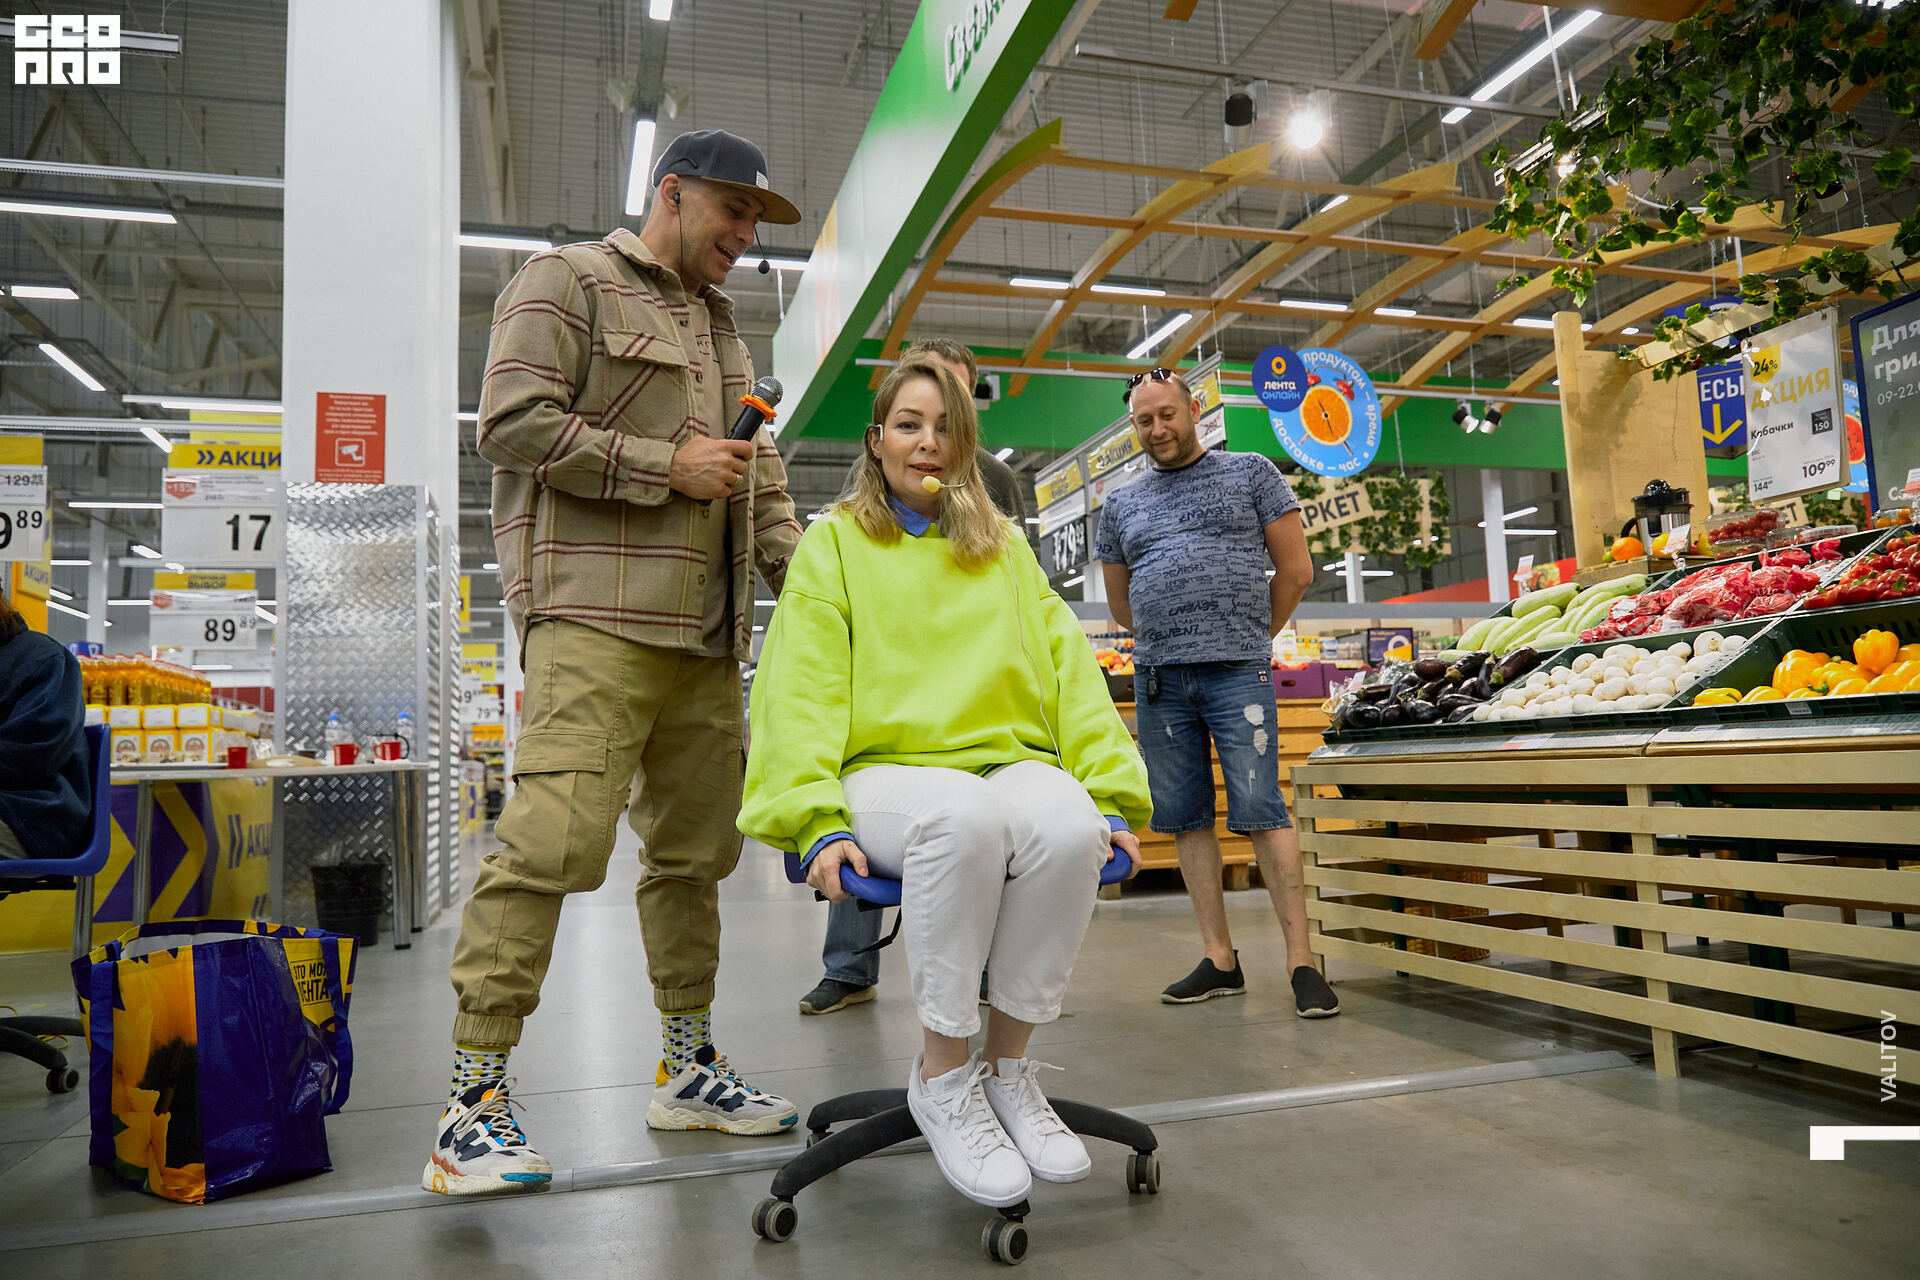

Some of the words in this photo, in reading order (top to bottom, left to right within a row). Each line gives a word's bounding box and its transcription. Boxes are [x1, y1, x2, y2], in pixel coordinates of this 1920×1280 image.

[1871, 323, 1920, 356] Для
[1874, 351, 1920, 383] гри
[1262, 390, 1300, 400] онлайн
[1264, 381, 1296, 390] лента
[1303, 351, 1366, 389] продуктам
[1365, 404, 1377, 447] время
[1751, 367, 1831, 413] АКЦИЯ
[1750, 421, 1794, 440] Кабачки
[1814, 420, 1830, 432] 150
[1273, 418, 1324, 470] доставке
[1338, 457, 1361, 472] час
[226, 514, 271, 551] 17
[205, 618, 236, 641] 89
